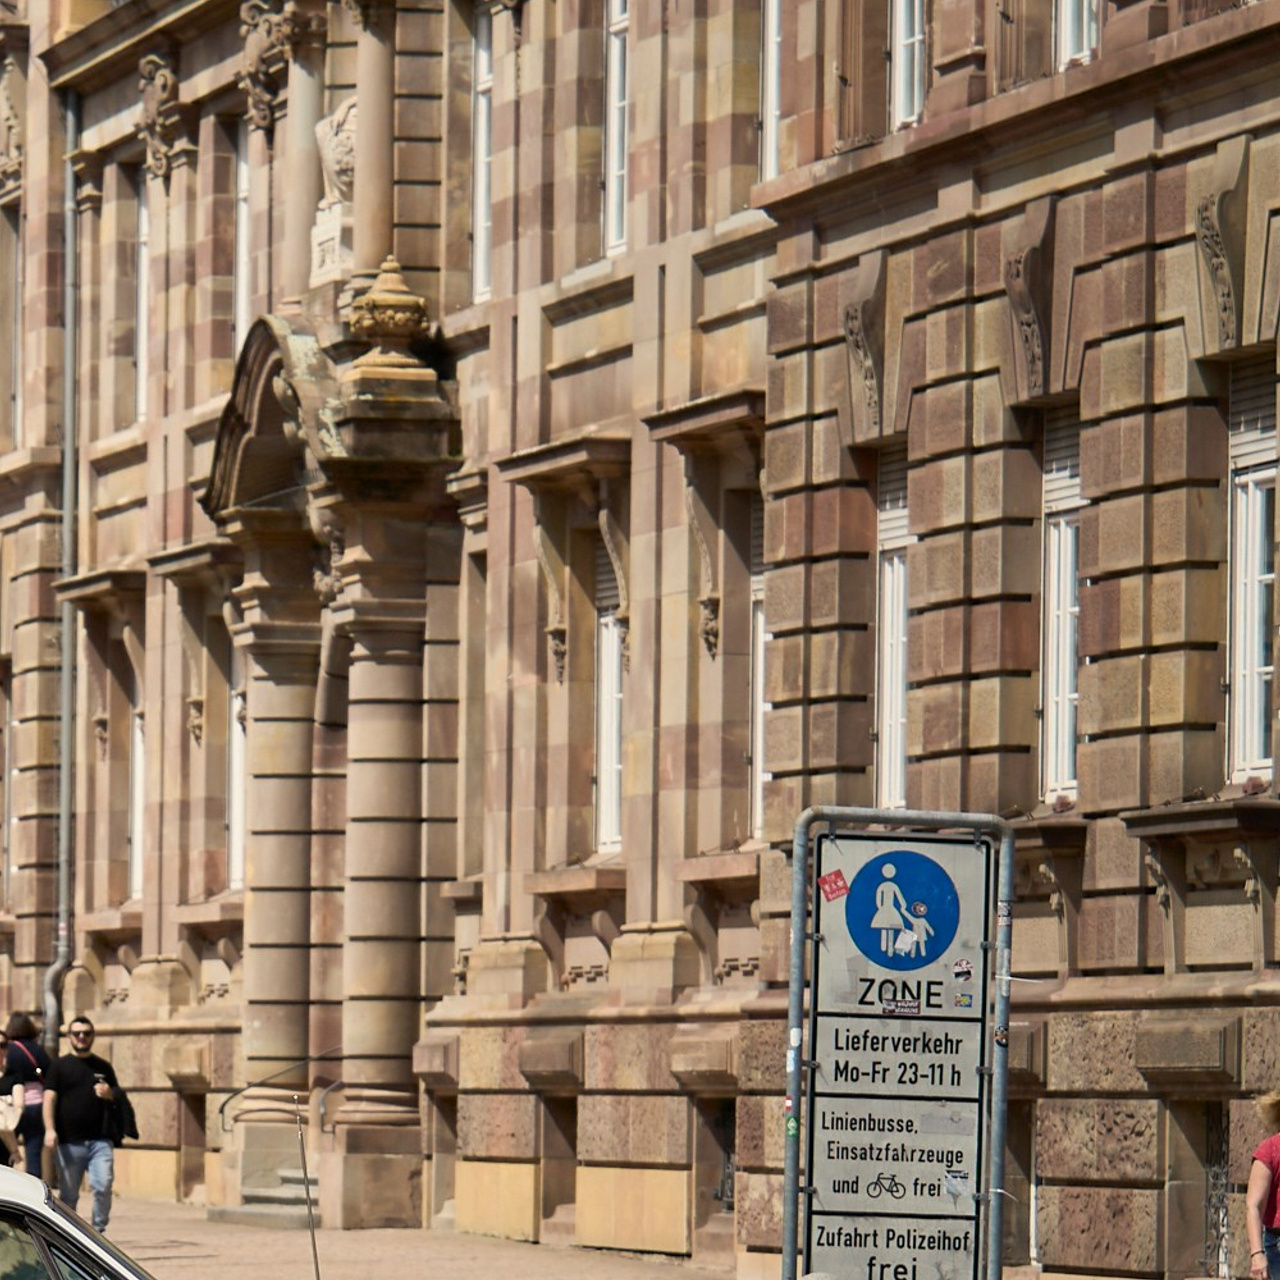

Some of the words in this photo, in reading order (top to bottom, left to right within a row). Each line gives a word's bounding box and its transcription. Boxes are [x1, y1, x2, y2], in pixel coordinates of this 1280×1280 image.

[858, 977, 944, 1009] ZONE
[834, 1028, 963, 1055] Lieferverkehr
[834, 1059, 890, 1083] Mo-Fr
[826, 1140, 964, 1168] Einsatzfahrzeuge
[832, 1175, 860, 1195] und
[912, 1177, 942, 1197] frei
[816, 1225, 879, 1249] Zufahrt
[885, 1227, 971, 1252] Polizeihof
